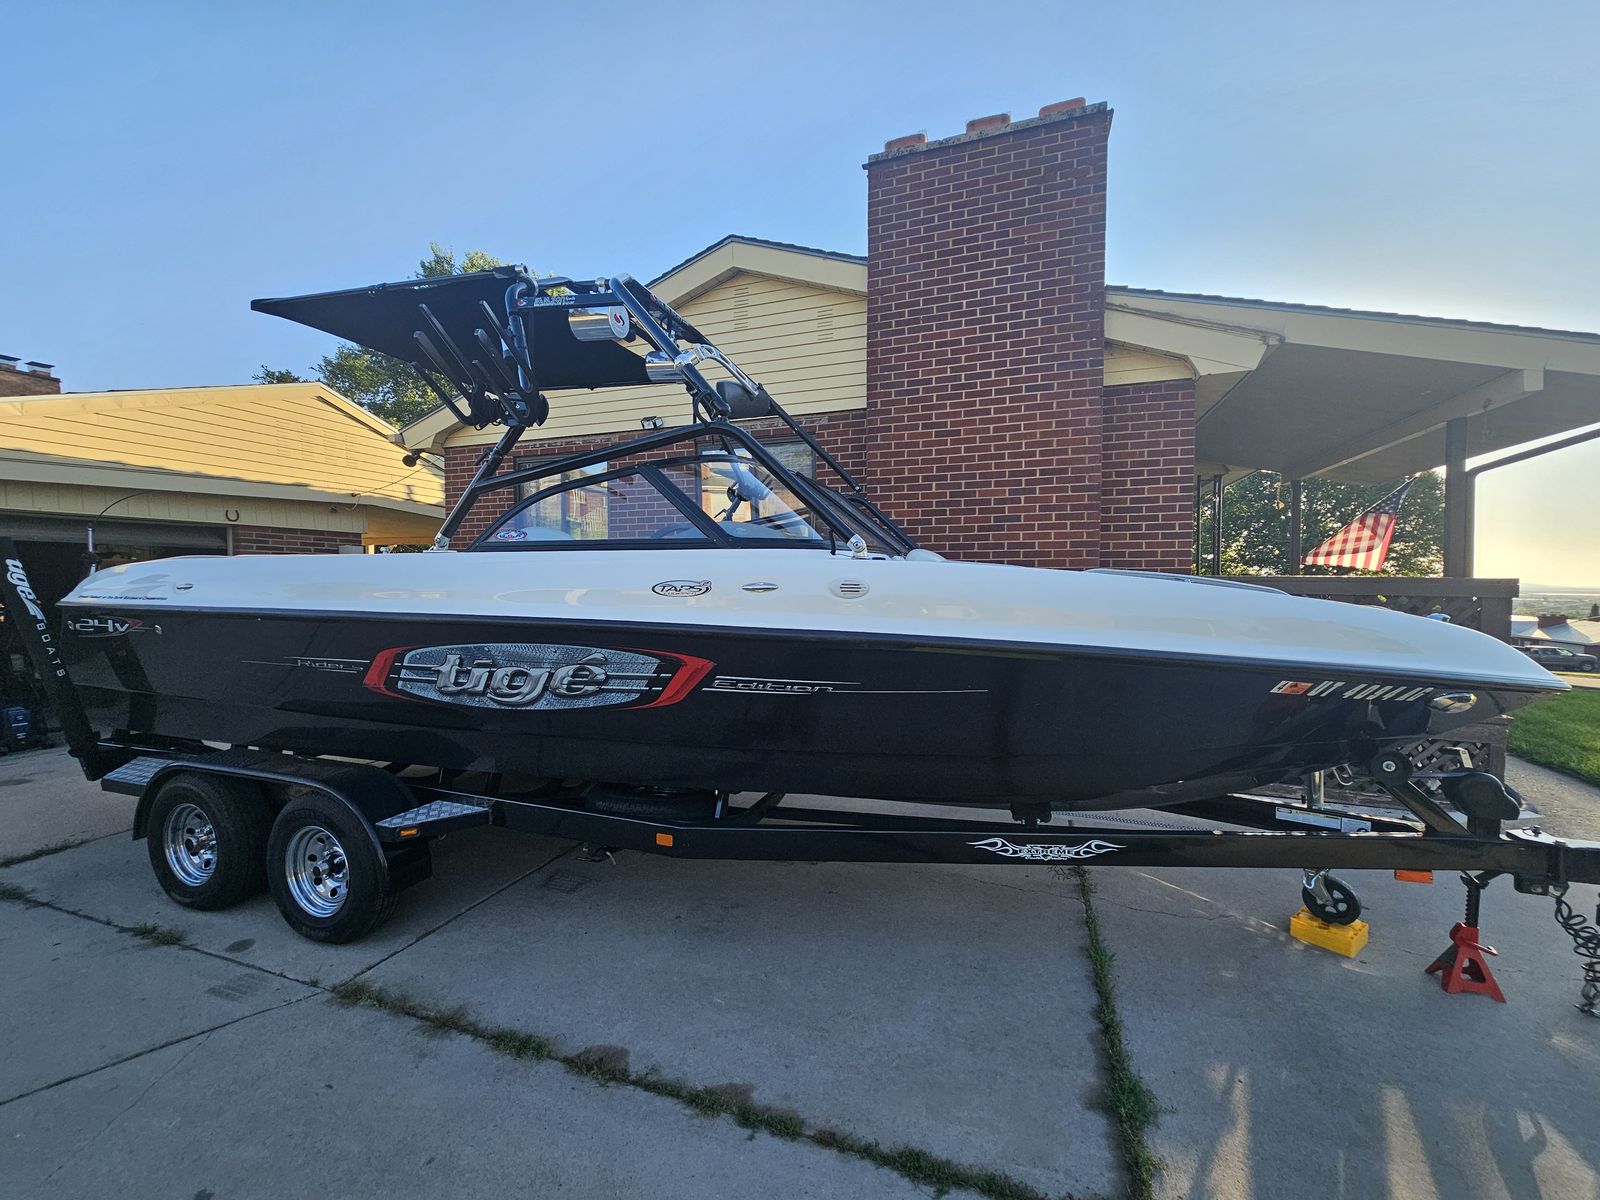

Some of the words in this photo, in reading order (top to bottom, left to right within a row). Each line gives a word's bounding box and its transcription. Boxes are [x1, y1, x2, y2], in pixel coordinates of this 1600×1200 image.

[36, 622, 66, 677] BOATS
[432, 652, 608, 704] tigé
[712, 679, 834, 692] Edition
[1307, 680, 1346, 697] UT
[1018, 847, 1075, 857] EXTREME
